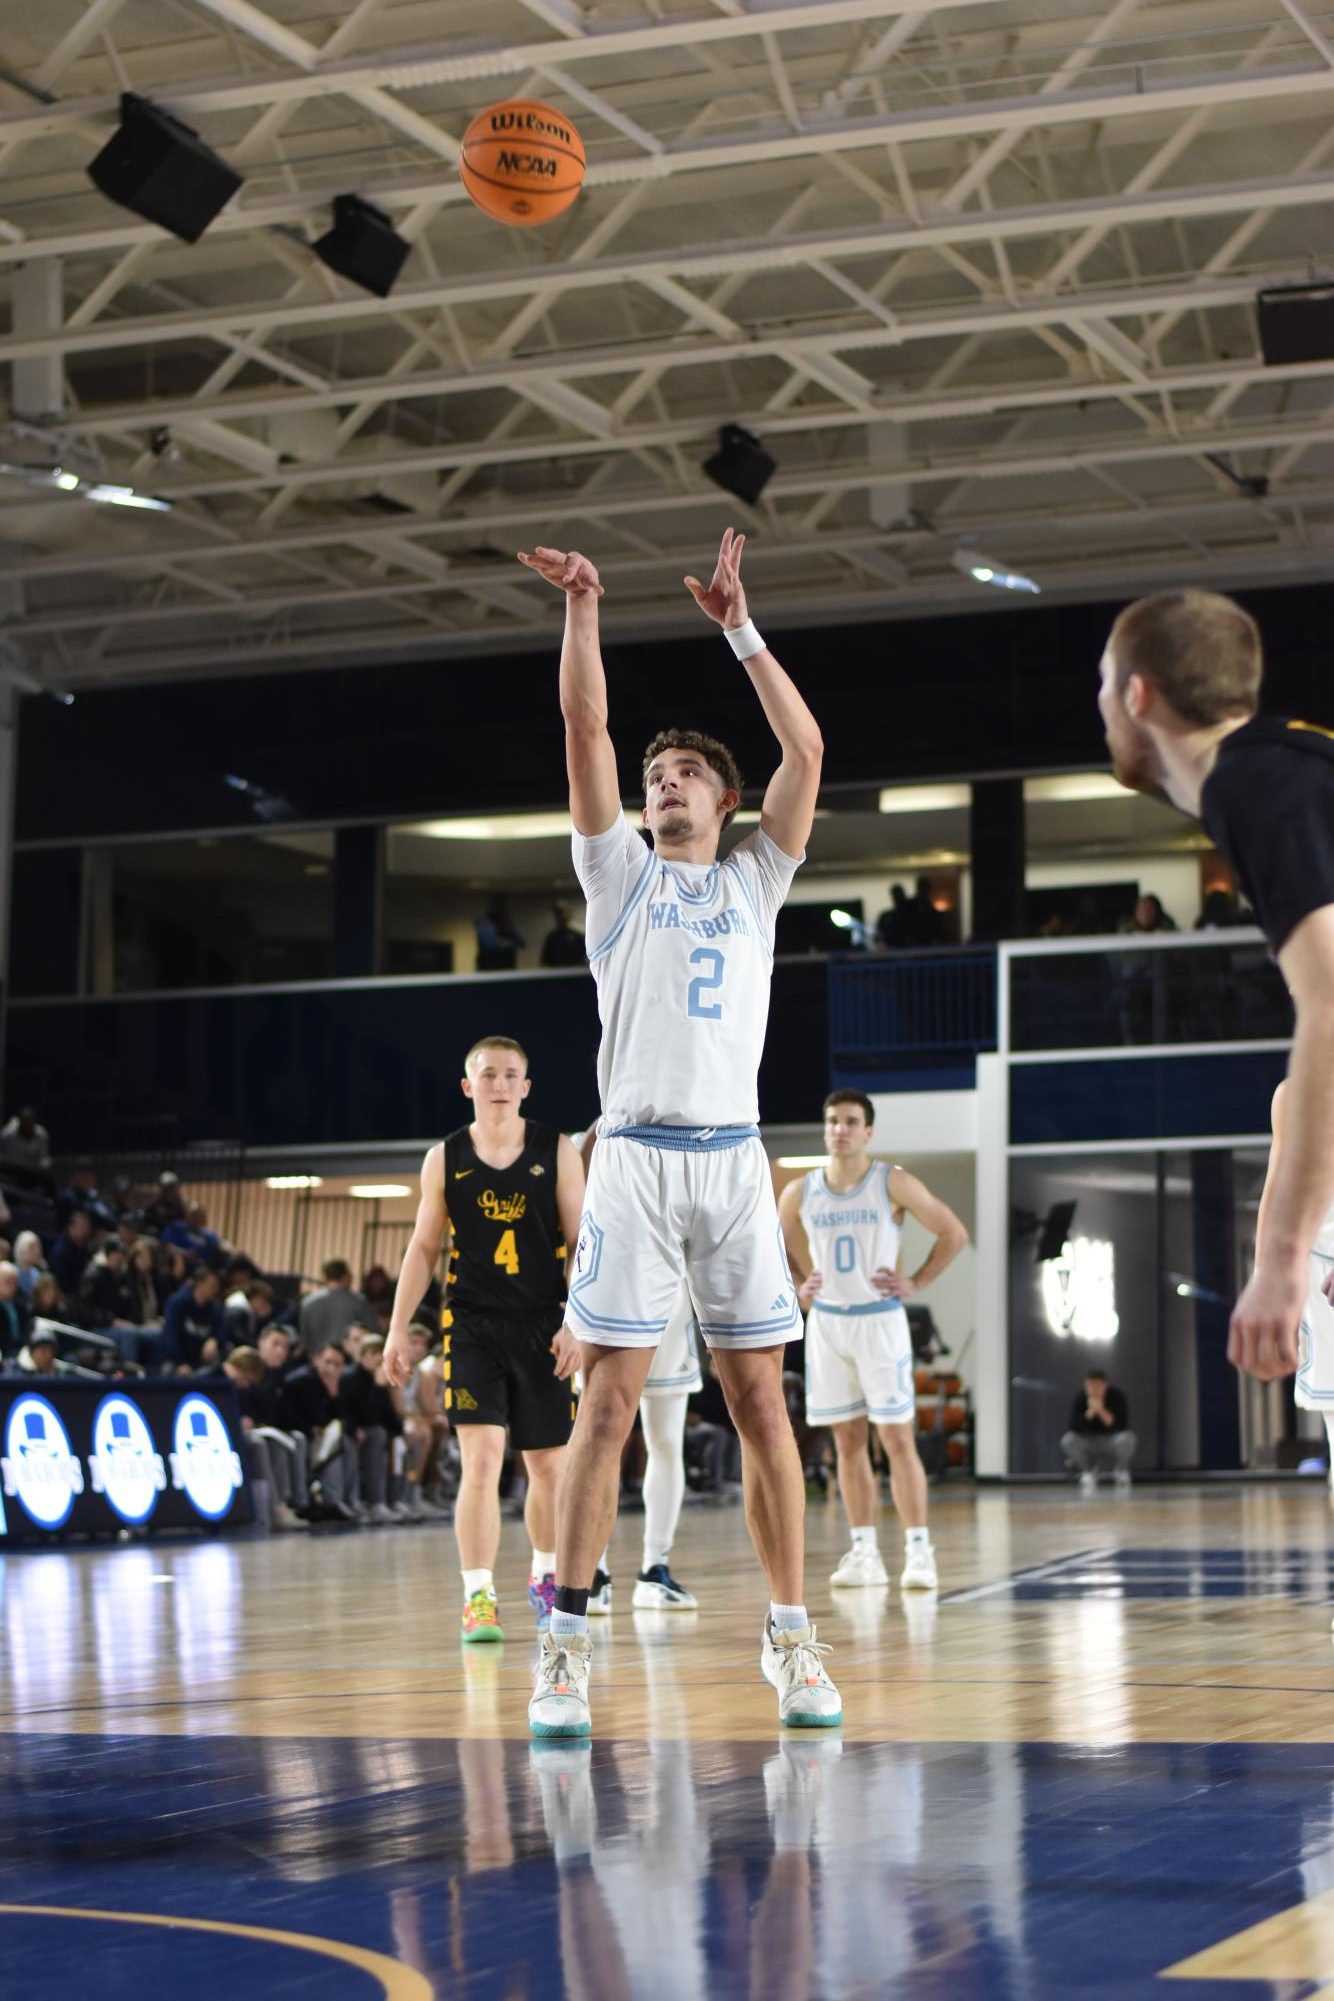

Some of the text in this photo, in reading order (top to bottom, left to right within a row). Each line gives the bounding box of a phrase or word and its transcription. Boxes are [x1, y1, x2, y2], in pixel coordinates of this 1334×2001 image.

[491, 111, 571, 145] Wilson
[496, 150, 557, 178] NCAA
[687, 947, 725, 1020] 2
[812, 1208, 879, 1229] WASHBURN
[494, 1229, 519, 1275] 4
[835, 1233, 856, 1273] 0
